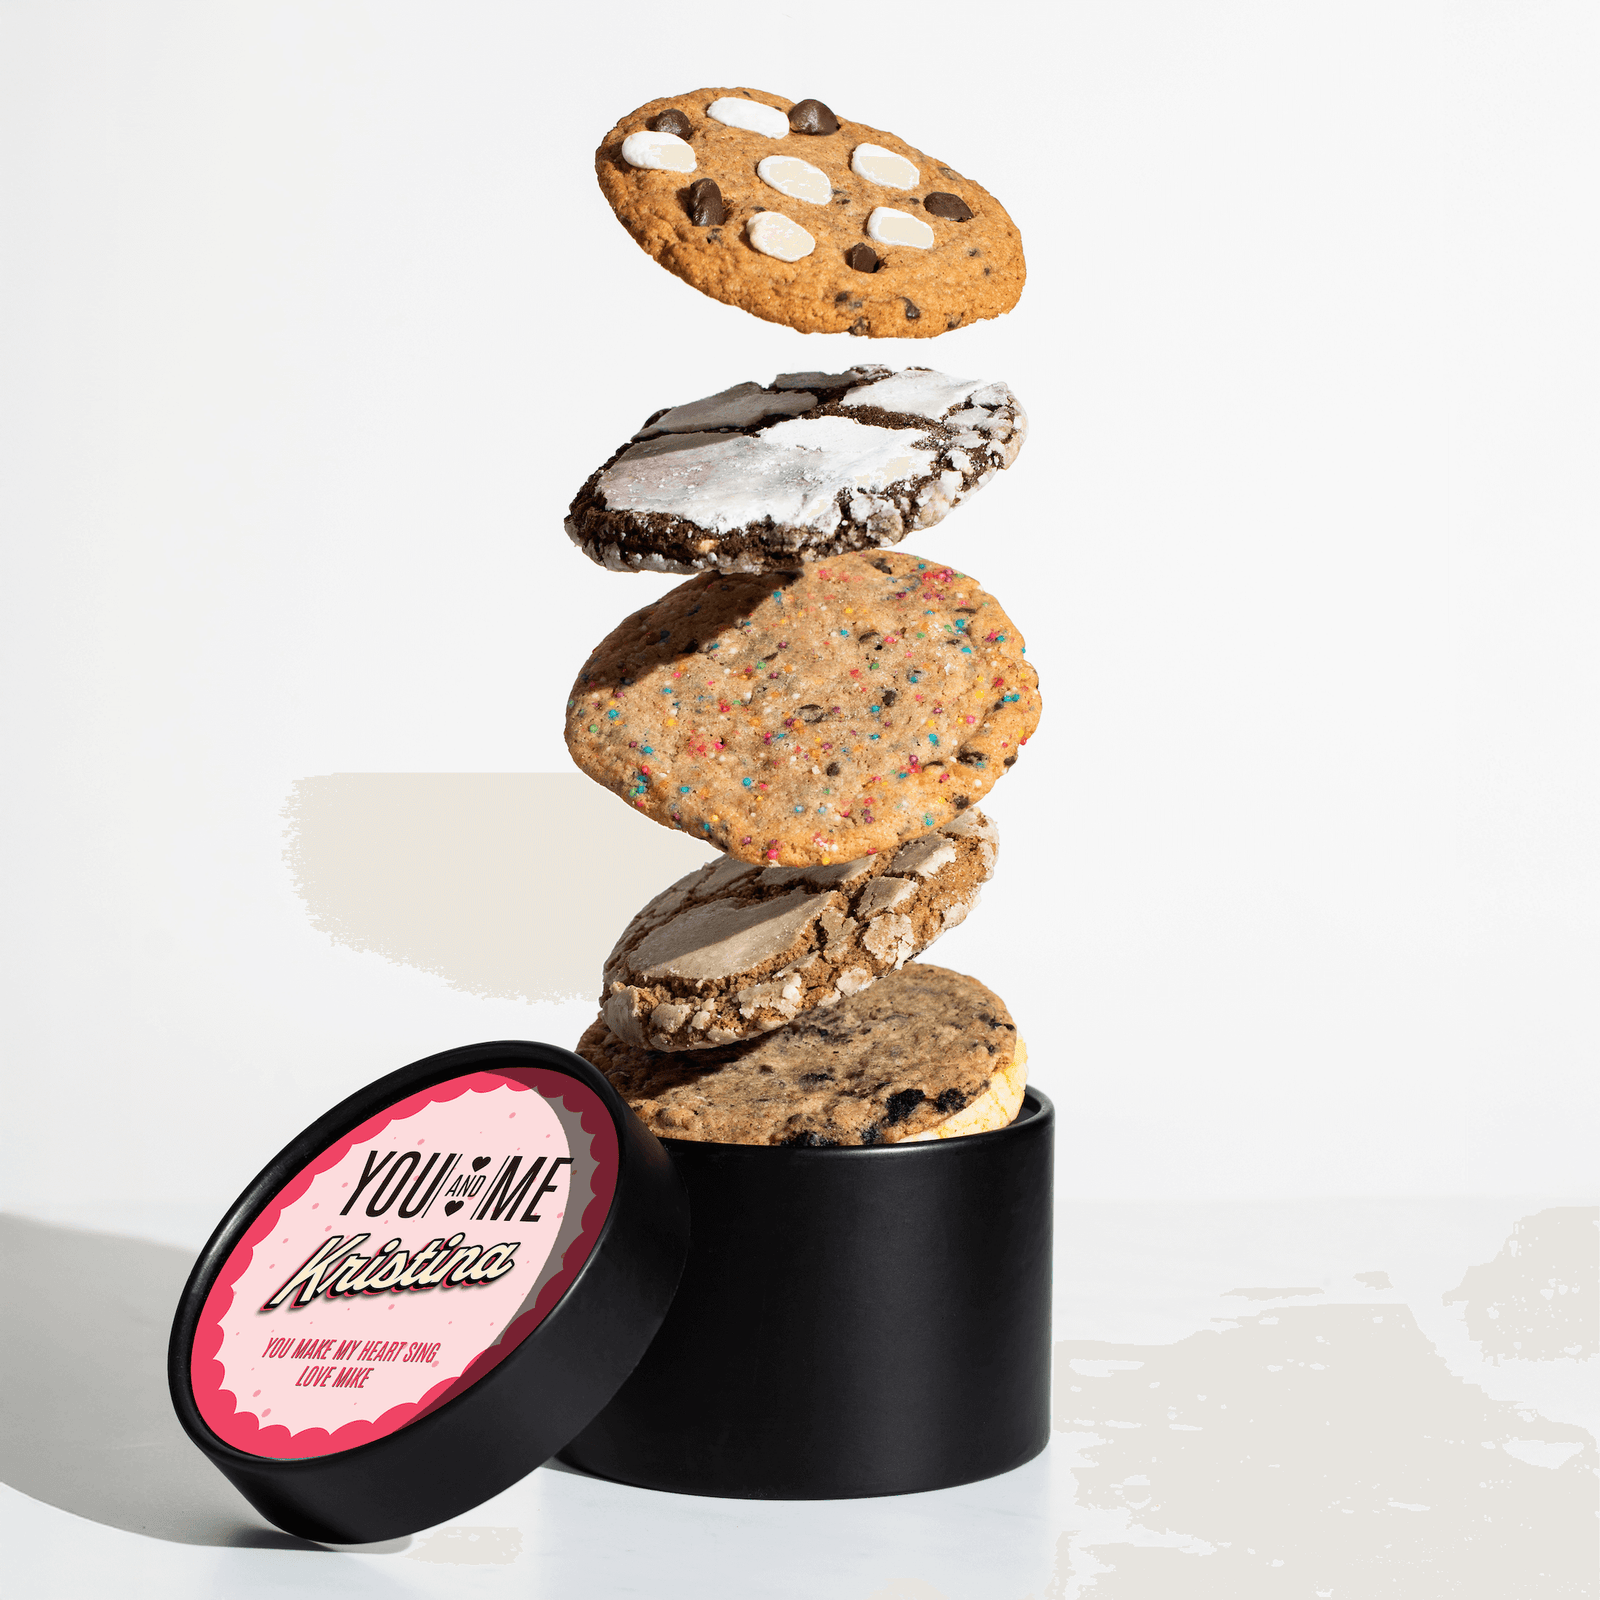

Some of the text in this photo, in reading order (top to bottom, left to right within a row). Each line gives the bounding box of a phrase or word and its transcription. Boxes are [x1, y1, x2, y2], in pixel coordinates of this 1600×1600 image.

[339, 1150, 575, 1223] YOU AND ME
[260, 1232, 521, 1311] Kristina
[262, 1337, 442, 1364] YOU MAKE MY HEART SING
[295, 1365, 375, 1389] LOVE MIKE
